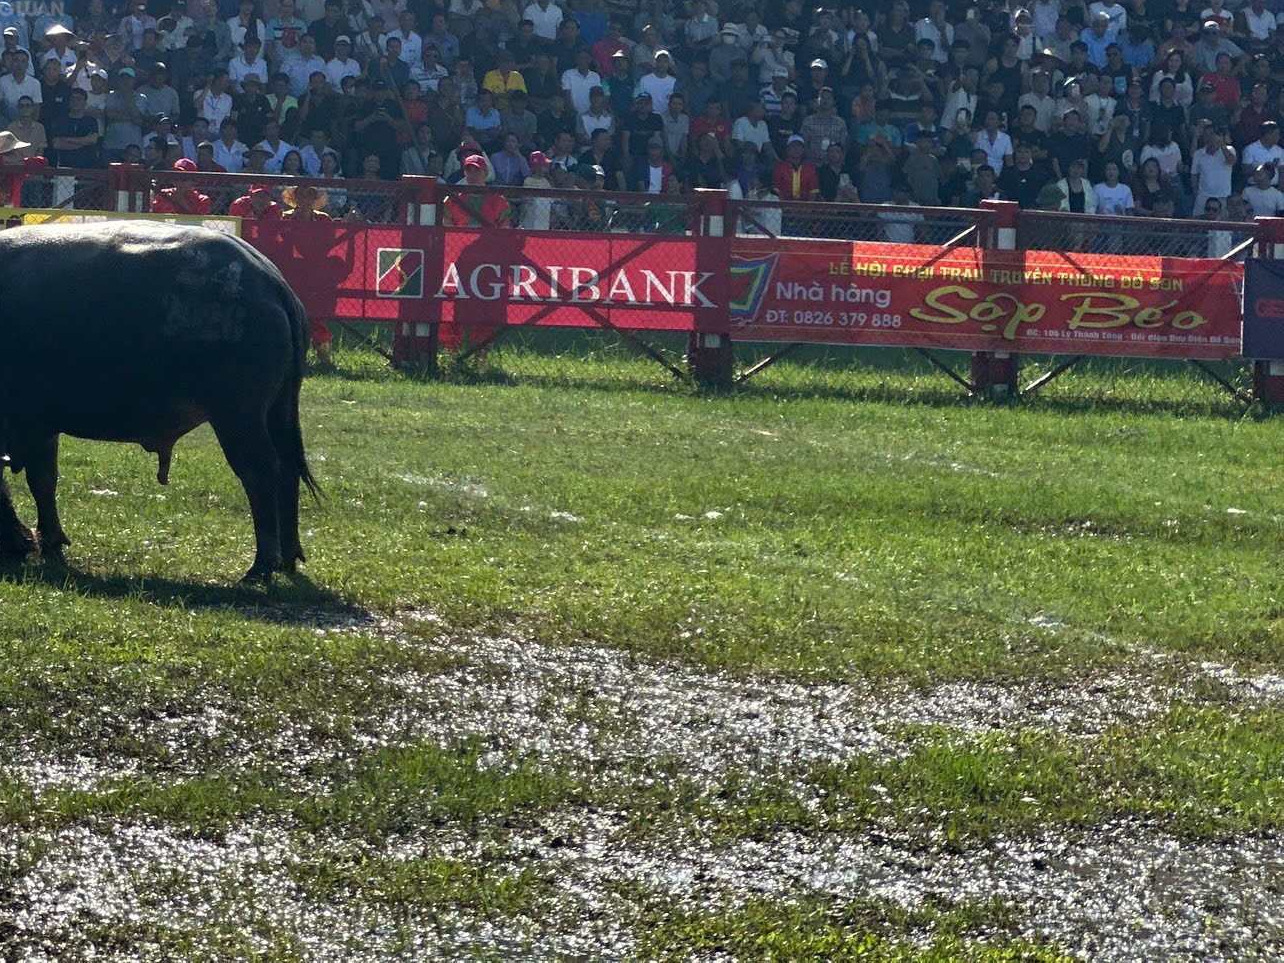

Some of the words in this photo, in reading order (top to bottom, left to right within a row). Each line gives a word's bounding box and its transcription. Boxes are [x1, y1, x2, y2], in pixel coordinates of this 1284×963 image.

[433, 260, 719, 309] AGRIBANK
[776, 281, 824, 301] Nhà
[831, 282, 892, 309] hàng
[793, 310, 834, 325] 0826
[838, 311, 868, 326] 379
[871, 313, 902, 328] 888
[1059, 292, 1208, 330] Béo
